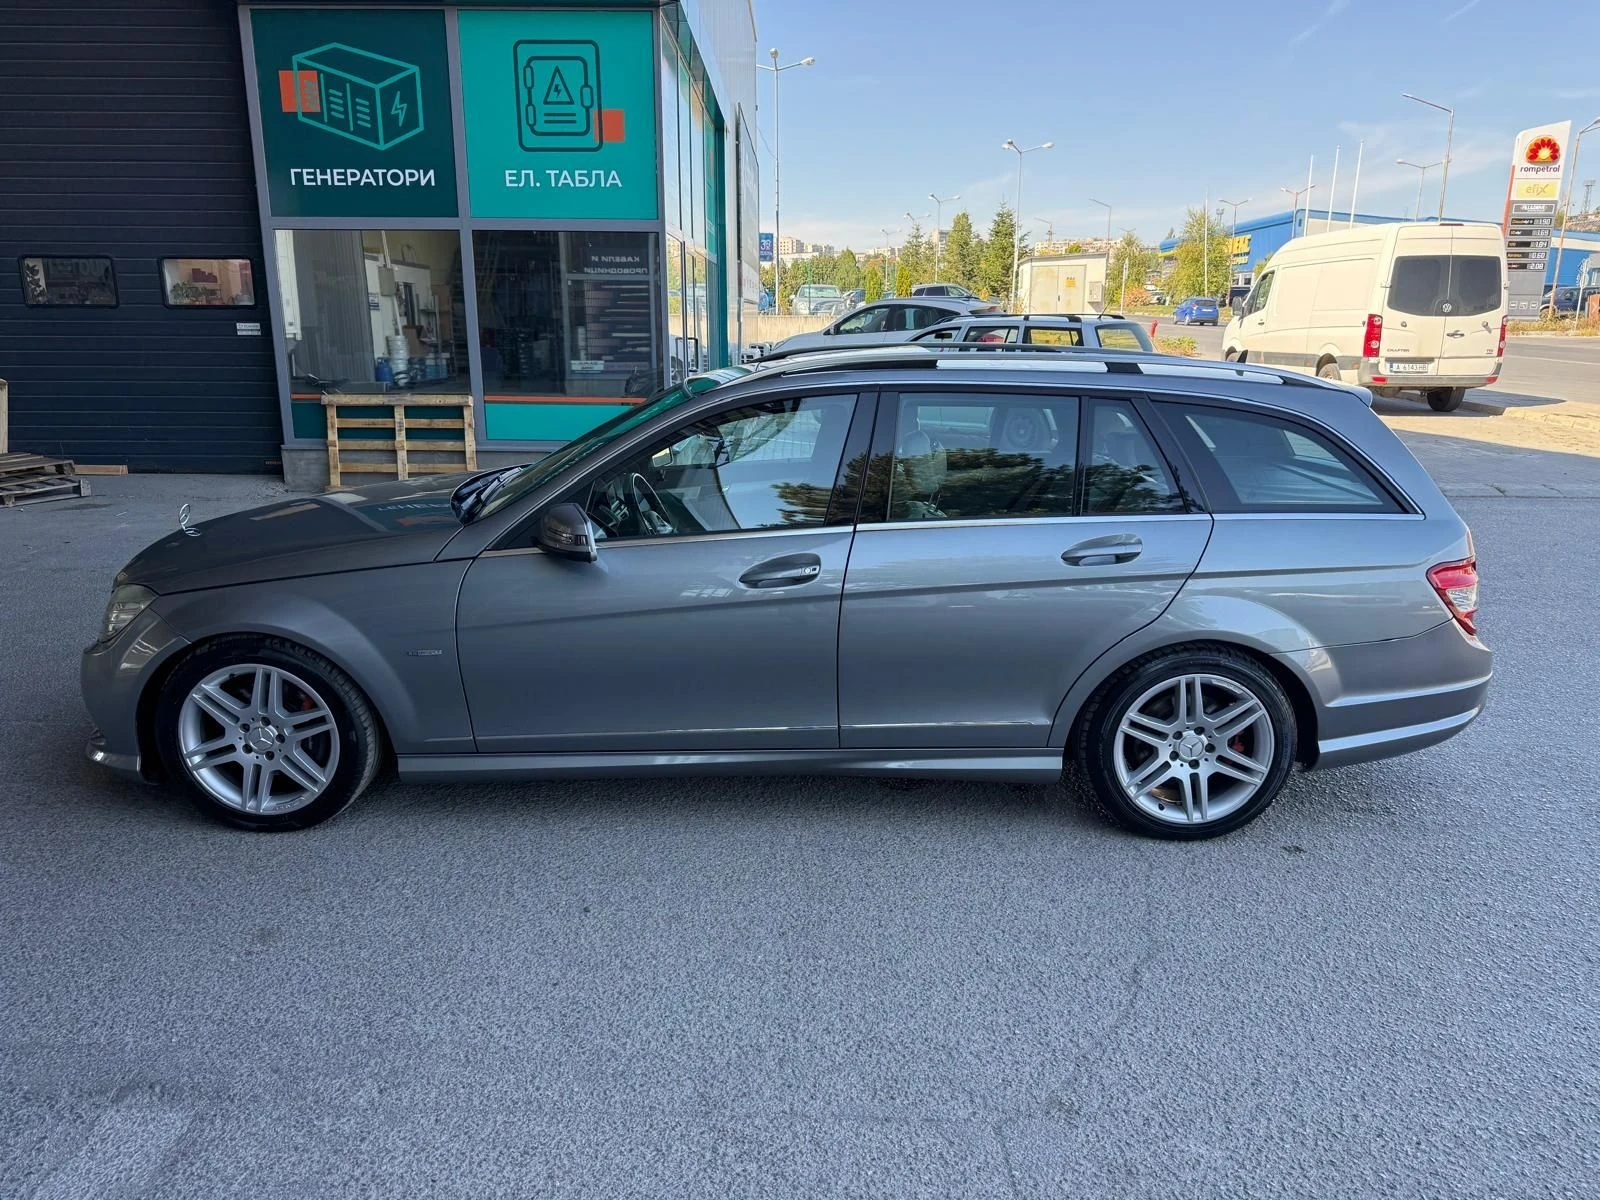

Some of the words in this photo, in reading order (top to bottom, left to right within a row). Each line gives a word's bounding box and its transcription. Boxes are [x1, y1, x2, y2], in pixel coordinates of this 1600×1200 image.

[1520, 164, 1560, 174] rompetrol
[290, 168, 436, 187] ГЕНЕРАТОРИ
[505, 170, 540, 188] ЕЛ.
[546, 169, 622, 188] ТАБЛА
[1526, 183, 1549, 196] efix
